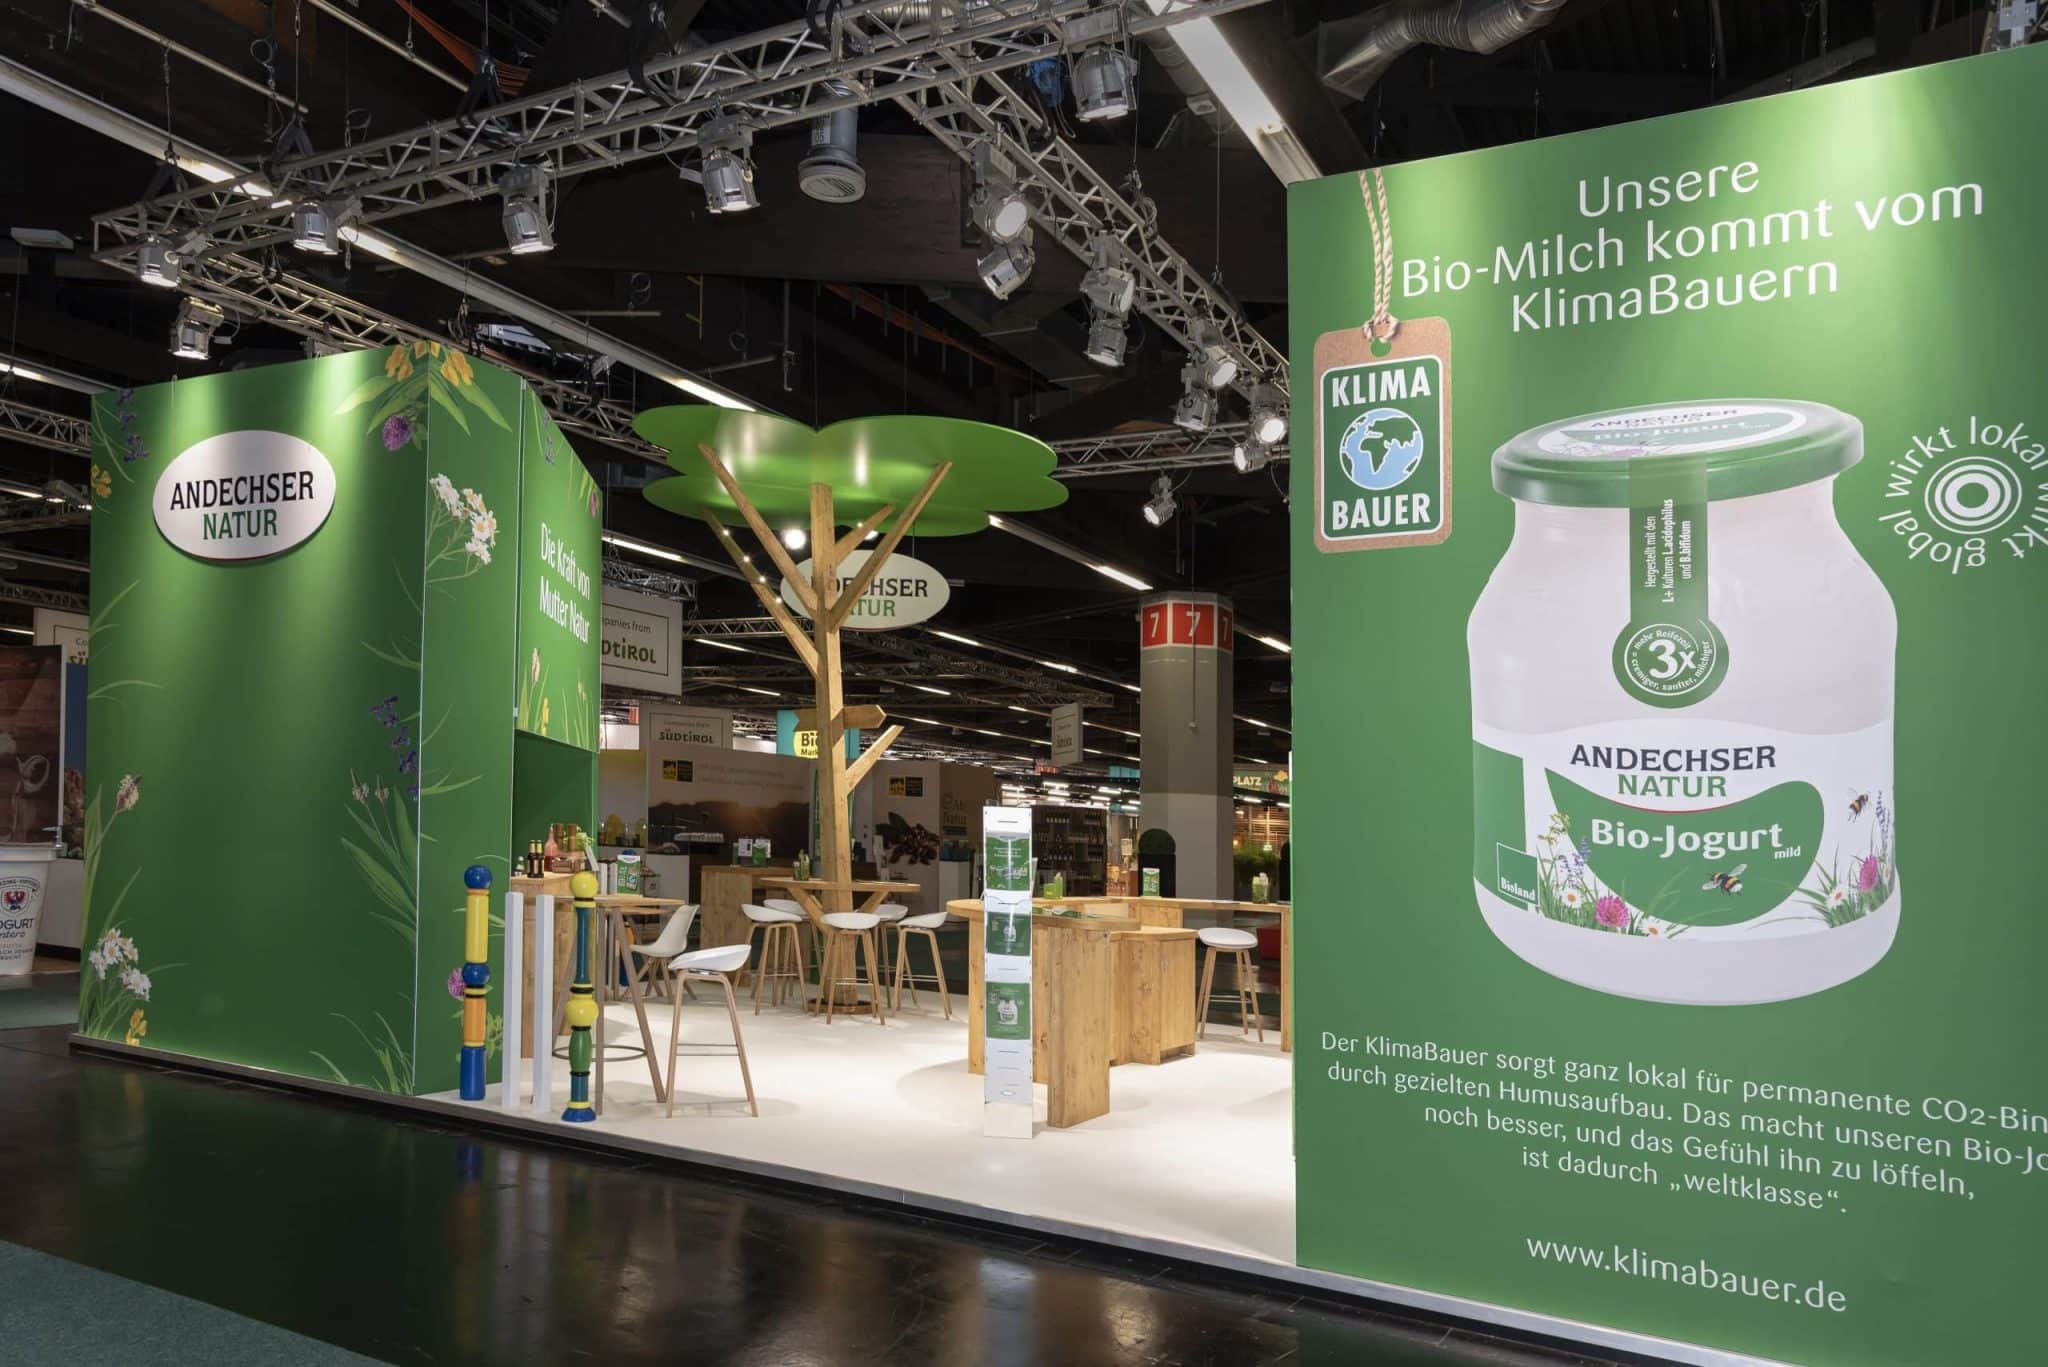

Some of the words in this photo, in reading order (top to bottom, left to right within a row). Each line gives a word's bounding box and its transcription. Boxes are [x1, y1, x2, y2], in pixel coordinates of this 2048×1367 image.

[1579, 161, 1759, 217] Unsere
[1402, 227, 1623, 297] Bio-Milch
[1647, 199, 1832, 262] kommt
[1854, 183, 1983, 231] vom
[1513, 261, 1837, 332] KlimaBauern
[1332, 366, 1431, 407] KLIMA
[1885, 426, 1957, 498] wirkt
[170, 470, 314, 511] ANDECHSER
[203, 508, 277, 540] NATUR
[1332, 493, 1431, 530] BAUER
[1644, 516, 1656, 531] den
[540, 522, 556, 569] Die
[557, 538, 576, 588] Kraft
[577, 567, 590, 600] von
[1878, 510, 1986, 575] global
[1644, 546, 1659, 588] Hergestellt
[1661, 556, 1674, 589] Kulturen
[1679, 564, 1691, 580] und
[540, 575, 568, 628] Mutter
[569, 600, 590, 643] Natur
[632, 621, 651, 633] from
[1150, 611, 1160, 638] 7
[1186, 611, 1201, 637] 7
[1649, 639, 1697, 681] 3x
[1570, 744, 1776, 772] ANDECHSER
[1617, 774, 1727, 797] NATUR
[1591, 819, 1783, 860] Bio-Jogurt
[1774, 846, 1800, 860] mild
[1501, 877, 1535, 901] Bioland
[1322, 1031, 1358, 1052] Der
[1366, 1035, 1488, 1066] KlimaBauer
[1496, 1053, 1556, 1079] sorgt
[1564, 1061, 1620, 1083] ganz
[1628, 1062, 1686, 1089] lokal
[1696, 1070, 1733, 1095] für
[1743, 1081, 1911, 1116] permanente
[1328, 1061, 1386, 1086] durch
[1394, 1071, 1490, 1099] gezielten
[1500, 1081, 1673, 1121] Humusaufbau.
[1683, 1102, 1730, 1128] Das
[1741, 1114, 1825, 1141] macht
[1835, 1125, 1951, 1157] unseren
[1425, 1105, 1478, 1128] noch
[1487, 1109, 1567, 1143] besser,
[1577, 1125, 1621, 1147] und
[1631, 1129, 1673, 1154] das
[1683, 1136, 1769, 1168] Gefühl
[1779, 1148, 1821, 1175] ihn
[1832, 1160, 1860, 1180] zu
[1873, 1159, 1974, 1200] löffeln,
[1523, 1146, 1549, 1169] ist
[1558, 1151, 1657, 1185] dadurch
[1526, 1237, 1847, 1312] www.klimabauer.de
